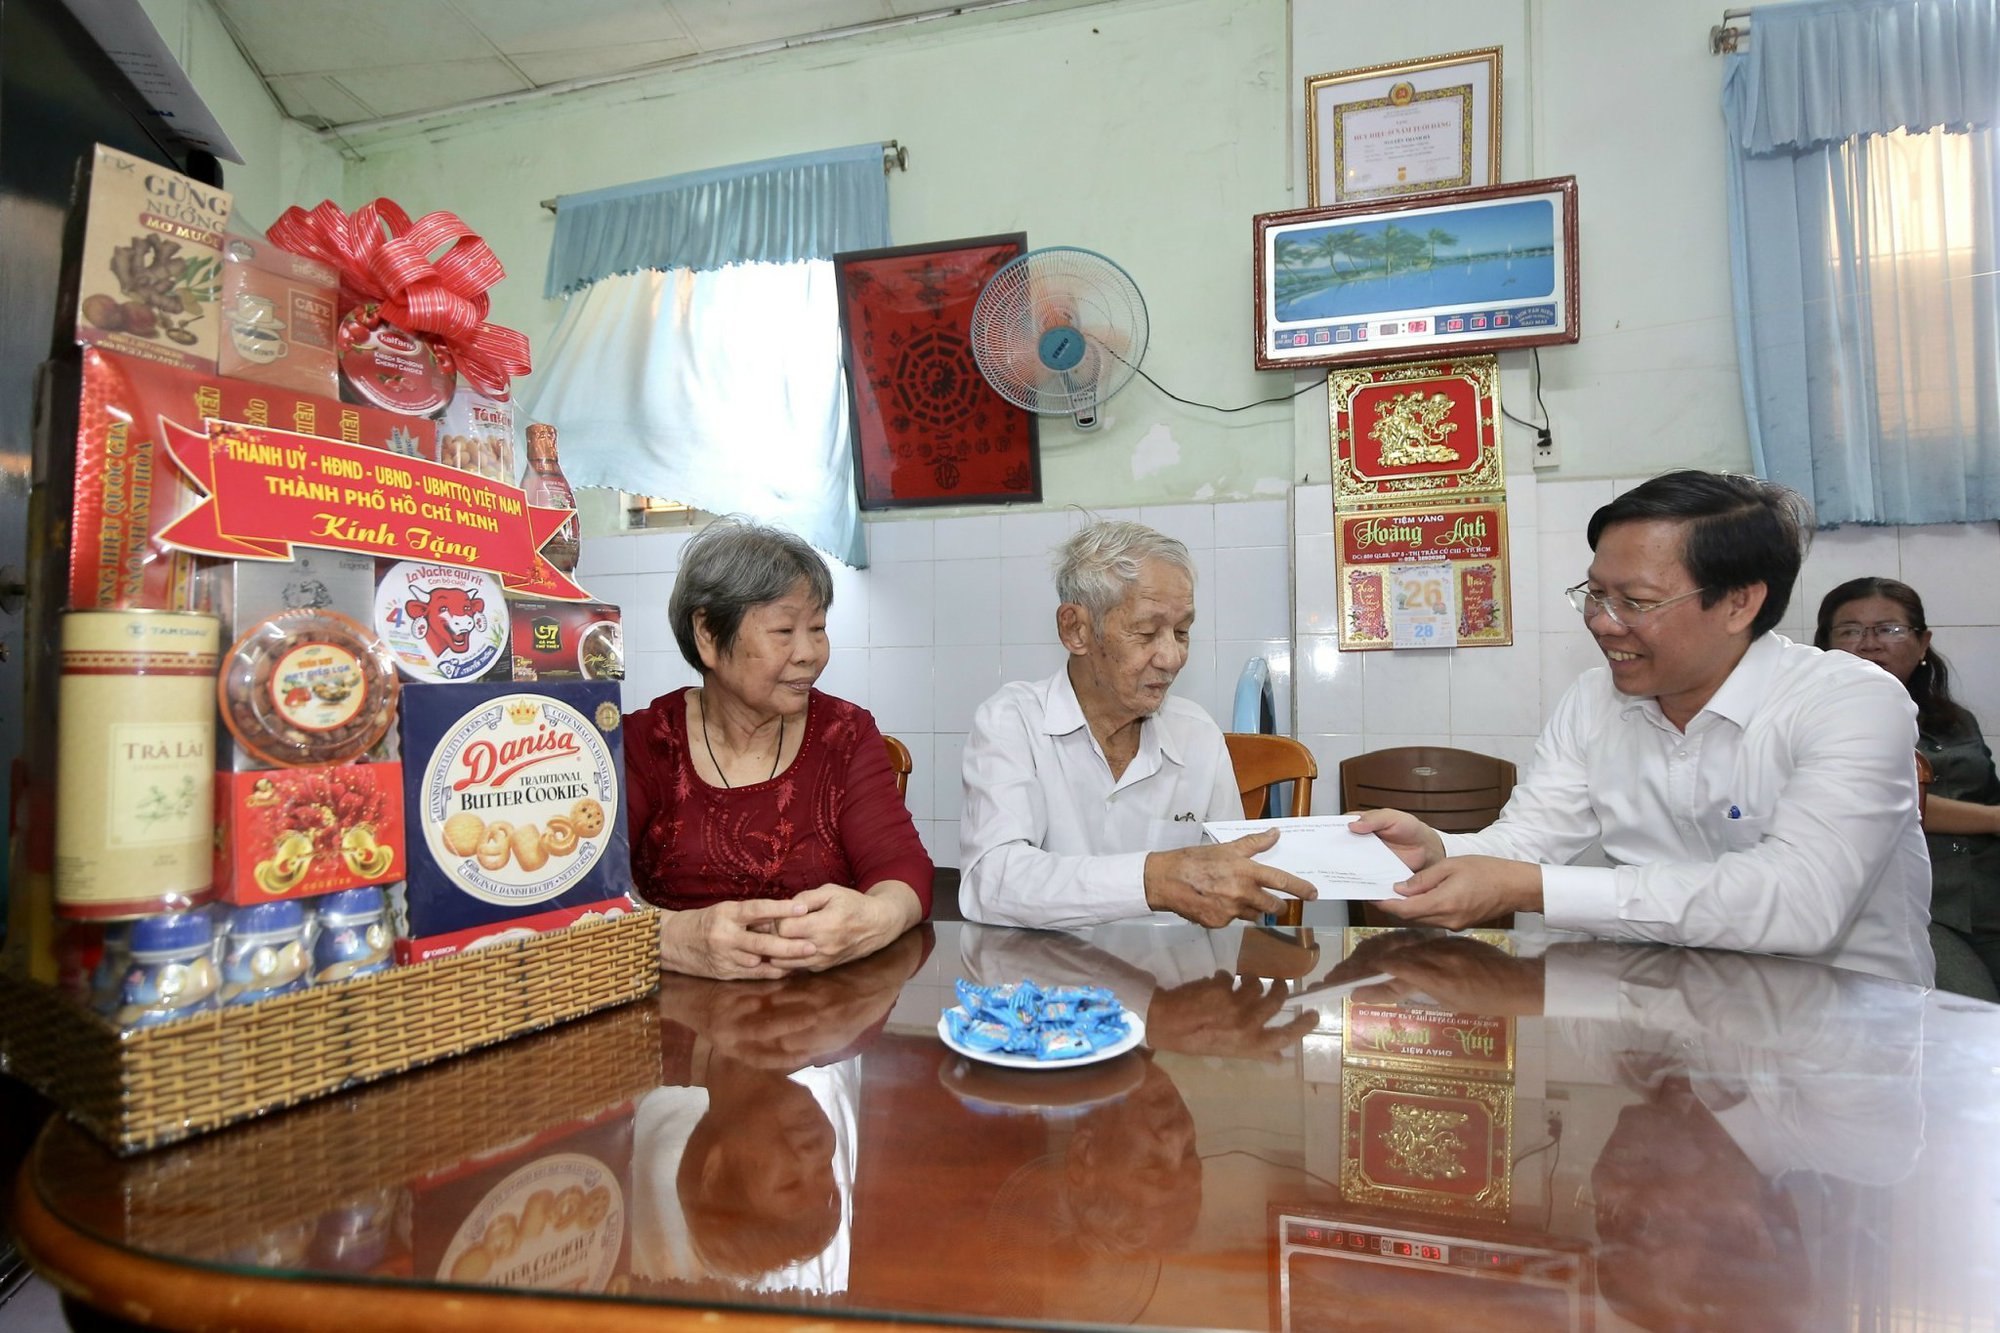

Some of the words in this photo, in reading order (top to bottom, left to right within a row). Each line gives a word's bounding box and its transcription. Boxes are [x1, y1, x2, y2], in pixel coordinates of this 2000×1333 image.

[145, 174, 227, 217] GỪNG
[146, 217, 174, 232] MƠ
[175, 224, 219, 249] MUỐI
[379, 333, 416, 351] kalfany
[398, 364, 423, 375] CANDIES
[293, 401, 315, 435] HIÊN
[339, 409, 360, 444] HIÊN
[105, 421, 128, 457] GIA
[321, 454, 363, 480] HĐND
[374, 465, 412, 489] UBND
[423, 475, 472, 507] UBMTTQ
[471, 486, 497, 513] VIỆT
[499, 498, 522, 517] NAM
[265, 475, 339, 504] THÀNH
[345, 488, 386, 511] PHỐ
[390, 493, 417, 515] HỒ
[421, 501, 452, 523] CHÍ
[456, 512, 499, 533] MINH
[1353, 517, 1423, 549] Hoàng
[1435, 515, 1487, 548] Anh
[1393, 516, 1415, 525] TIỆM
[1417, 514, 1444, 523] VÀNG
[309, 512, 400, 547] Kính
[405, 526, 481, 563] Tặng
[406, 572, 419, 583] La
[417, 566, 453, 578] Vache
[454, 568, 471, 581] qui
[471, 575, 484, 586] rit
[1404, 580, 1444, 608] 26
[386, 607, 405, 629] 4
[534, 624, 559, 640] G7
[1415, 624, 1434, 638] 28
[445, 664, 453, 675] 8
[122, 740, 170, 760] TRÀ
[453, 724, 580, 792] Danisa
[552, 709, 596, 749] COPENHAGEN
[594, 749, 611, 791] DENMARK
[520, 771, 582, 787] TRADITIONAL
[461, 790, 523, 811] BUTTER
[525, 783, 589, 804] COOKIES
[463, 870, 499, 894] ORIGINAL
[499, 885, 528, 896] DANISH
[528, 880, 555, 895] RECIPE
